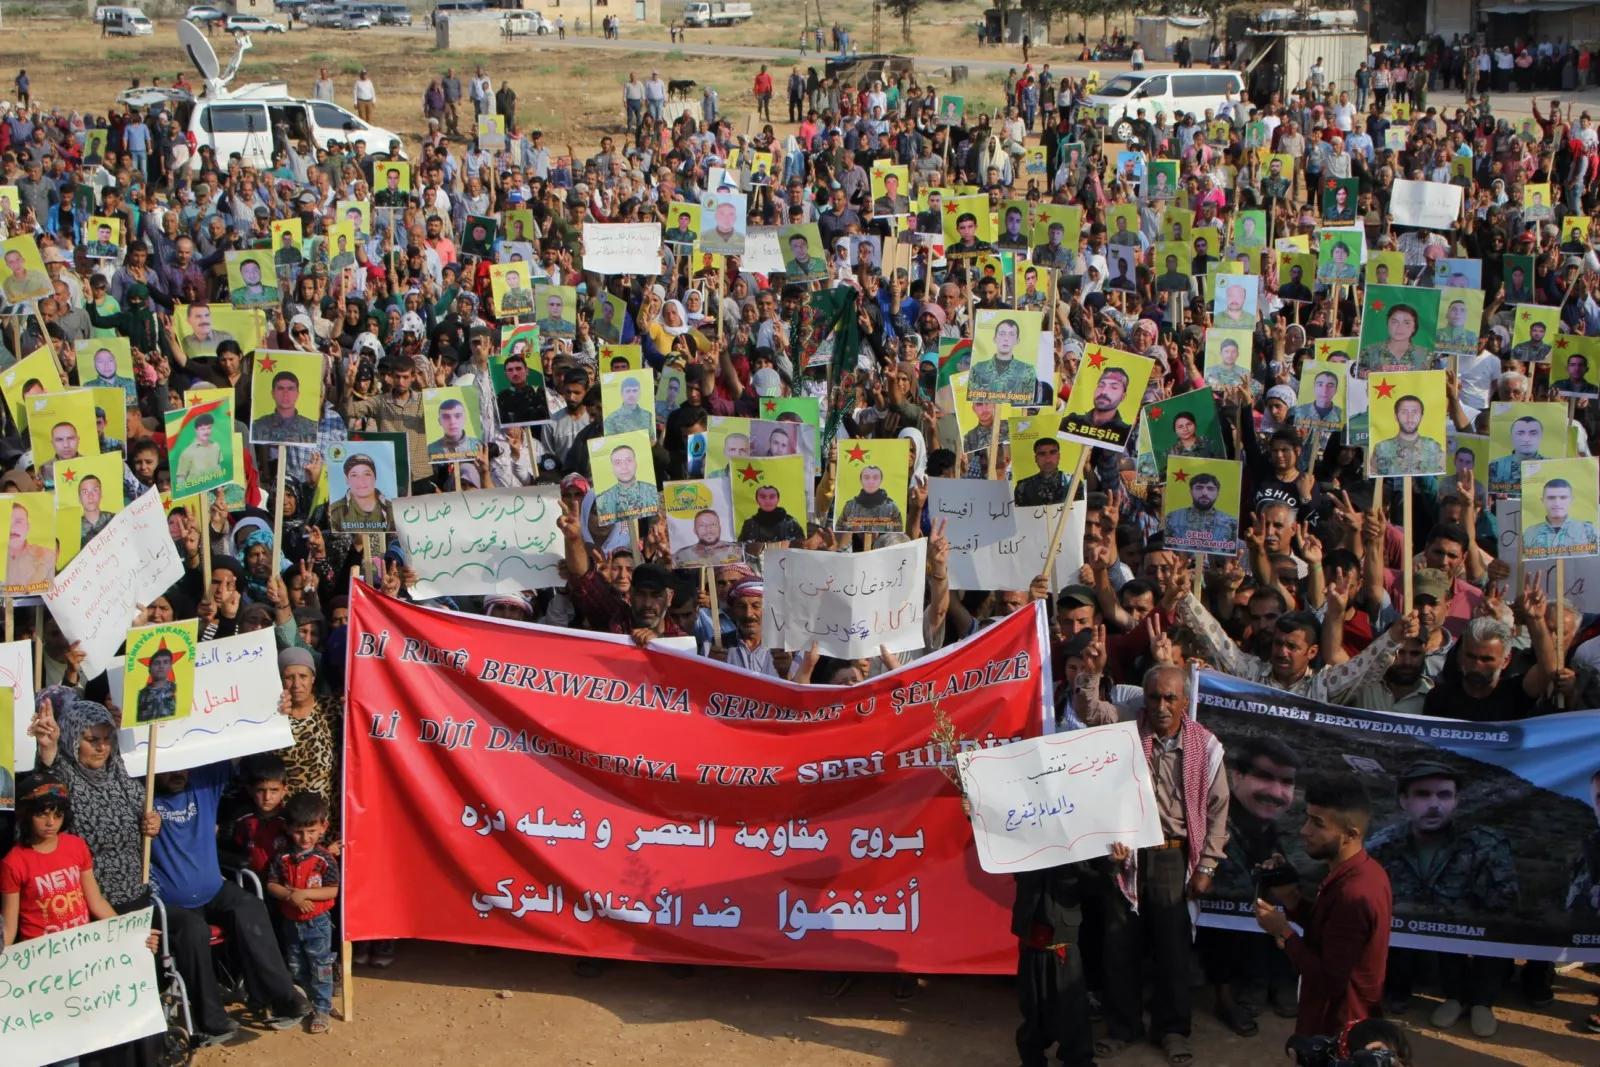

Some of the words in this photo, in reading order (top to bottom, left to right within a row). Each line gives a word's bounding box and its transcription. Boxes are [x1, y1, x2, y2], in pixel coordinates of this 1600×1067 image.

[1067, 421, 1120, 442] Ş.BEŞİR
[403, 502, 451, 523] ضمان
[1256, 488, 1297, 507] ASHIO
[95, 552, 119, 576] strong
[478, 658, 692, 713] BERXWEDANA
[891, 650, 1032, 714] ŞÊLADİZÊ
[1198, 692, 1310, 720] FERMANDARÊN
[1314, 712, 1425, 737] BERXWEDANA
[1430, 727, 1509, 742] SERDEMÊ
[696, 763, 783, 787] TURK
[796, 751, 886, 784] SERÎ
[516, 807, 587, 846] شيله
[592, 818, 612, 849] و
[626, 818, 716, 851] العصر
[734, 818, 829, 857] مقاومة
[850, 827, 924, 859] بروح
[34, 865, 80, 899] NEW
[471, 878, 564, 919] التركي
[573, 887, 683, 926] الأحتلال
[692, 897, 742, 928] ضد
[778, 877, 920, 940] أنتفضوا
[1201, 900, 1235, 911] EHİD
[1408, 920, 1486, 936] QEHREMAN
[1572, 933, 1600, 946] ŞEH
